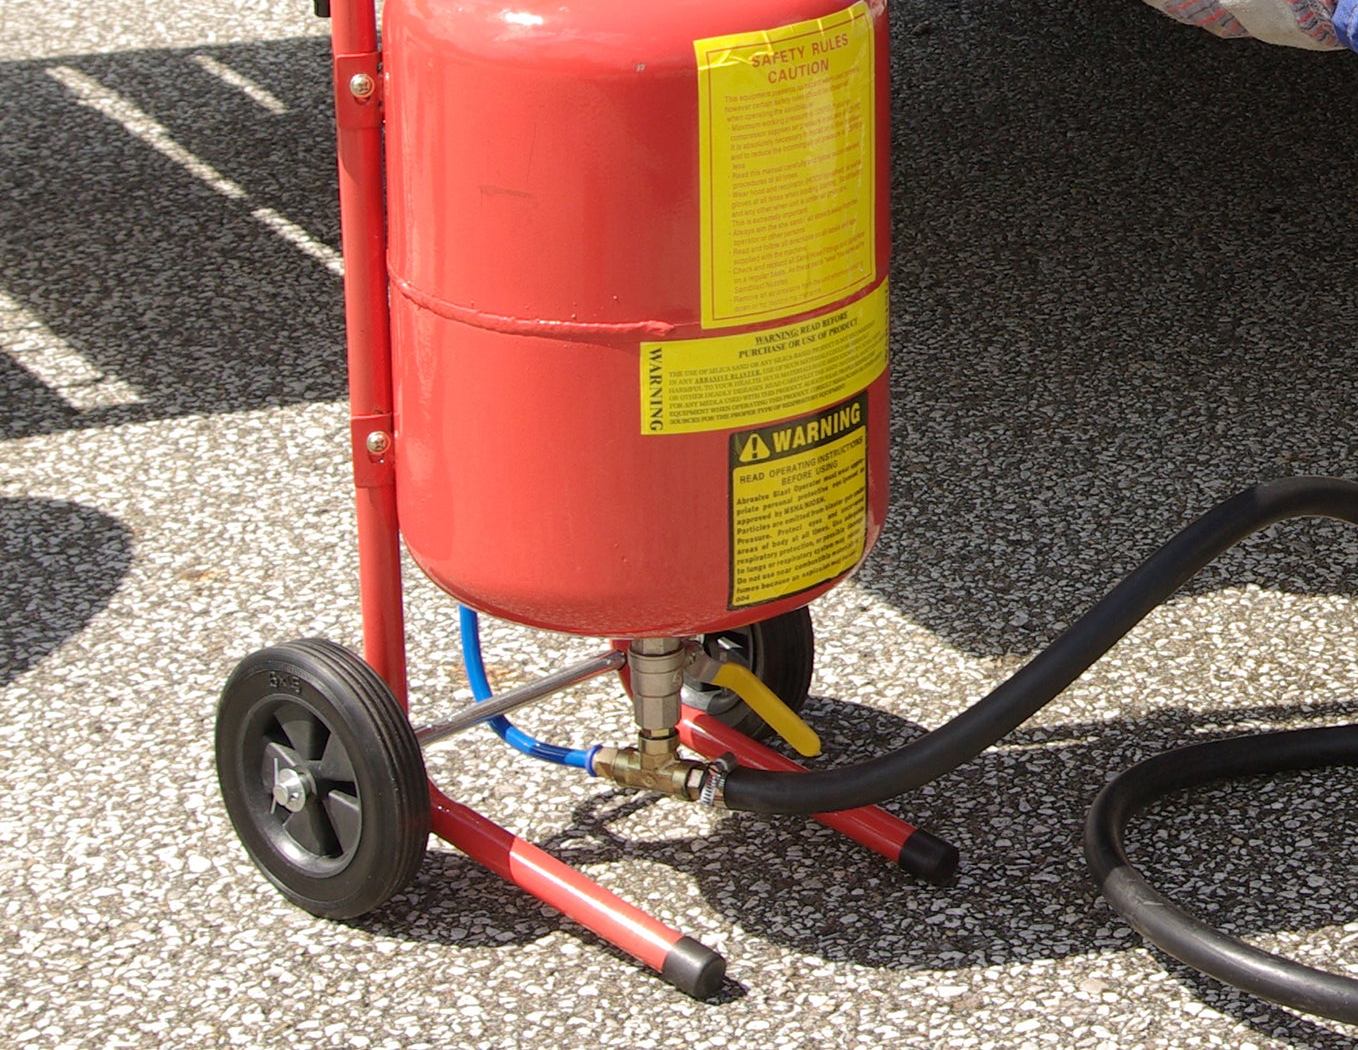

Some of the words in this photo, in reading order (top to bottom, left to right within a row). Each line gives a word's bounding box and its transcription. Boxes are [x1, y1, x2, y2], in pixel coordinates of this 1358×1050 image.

[752, 47, 804, 68] SAFETY
[812, 33, 849, 55] RULES
[768, 60, 829, 84] CAUTION
[739, 344, 787, 358] PURCHASE
[788, 339, 800, 347] OR
[801, 335, 816, 345] USE
[817, 331, 828, 341] OF
[828, 319, 858, 336] PRODUCT
[755, 329, 800, 344] WARNING:
[800, 322, 822, 334] READ
[822, 312, 848, 327] BEFORE
[708, 366, 731, 374] SILICA
[732, 363, 749, 371] SAND
[650, 347, 663, 431] WARNING
[705, 389, 732, 398] DEADLY
[669, 408, 710, 417] EQUIPMENT
[732, 399, 768, 410] OPERATING
[769, 396, 783, 404] THIS
[731, 409, 756, 418] PROPER
[757, 406, 772, 414] TYPE
[772, 402, 861, 453] WARNING
[740, 472, 765, 484] READ
[769, 458, 816, 478] OPERATING
[817, 435, 863, 464] INSTRUCTIONS
[782, 469, 812, 485] BEFORE
[816, 459, 838, 475] USING
[737, 493, 769, 505] Abrasive
[773, 488, 791, 498] Blast
[794, 477, 821, 494] Operator
[737, 506, 759, 517] priate
[763, 498, 793, 512] personal
[798, 484, 828, 503] protective
[737, 513, 771, 527] approved
[775, 510, 782, 519] by
[737, 523, 770, 535] Particles
[773, 521, 783, 529] are
[786, 512, 809, 525] emitted
[811, 506, 824, 517] from
[778, 524, 802, 538] Protect
[809, 518, 822, 529] eyes
[828, 510, 837, 520] and
[737, 547, 758, 555] areas
[762, 543, 769, 551] of
[772, 538, 788, 550] body
[792, 535, 799, 543] at
[812, 523, 829, 536] times.
[737, 551, 777, 566] respiratory
[824, 525, 844, 543] possible
[747, 564, 766, 575] lungs
[777, 550, 812, 569] respiratory
[814, 542, 833, 557] system
[749, 575, 760, 583] not
[777, 569, 791, 577] near
[795, 553, 830, 572] combustible
[737, 585, 759, 594] fumes
[761, 577, 790, 590] because
[802, 563, 829, 580] explosion
